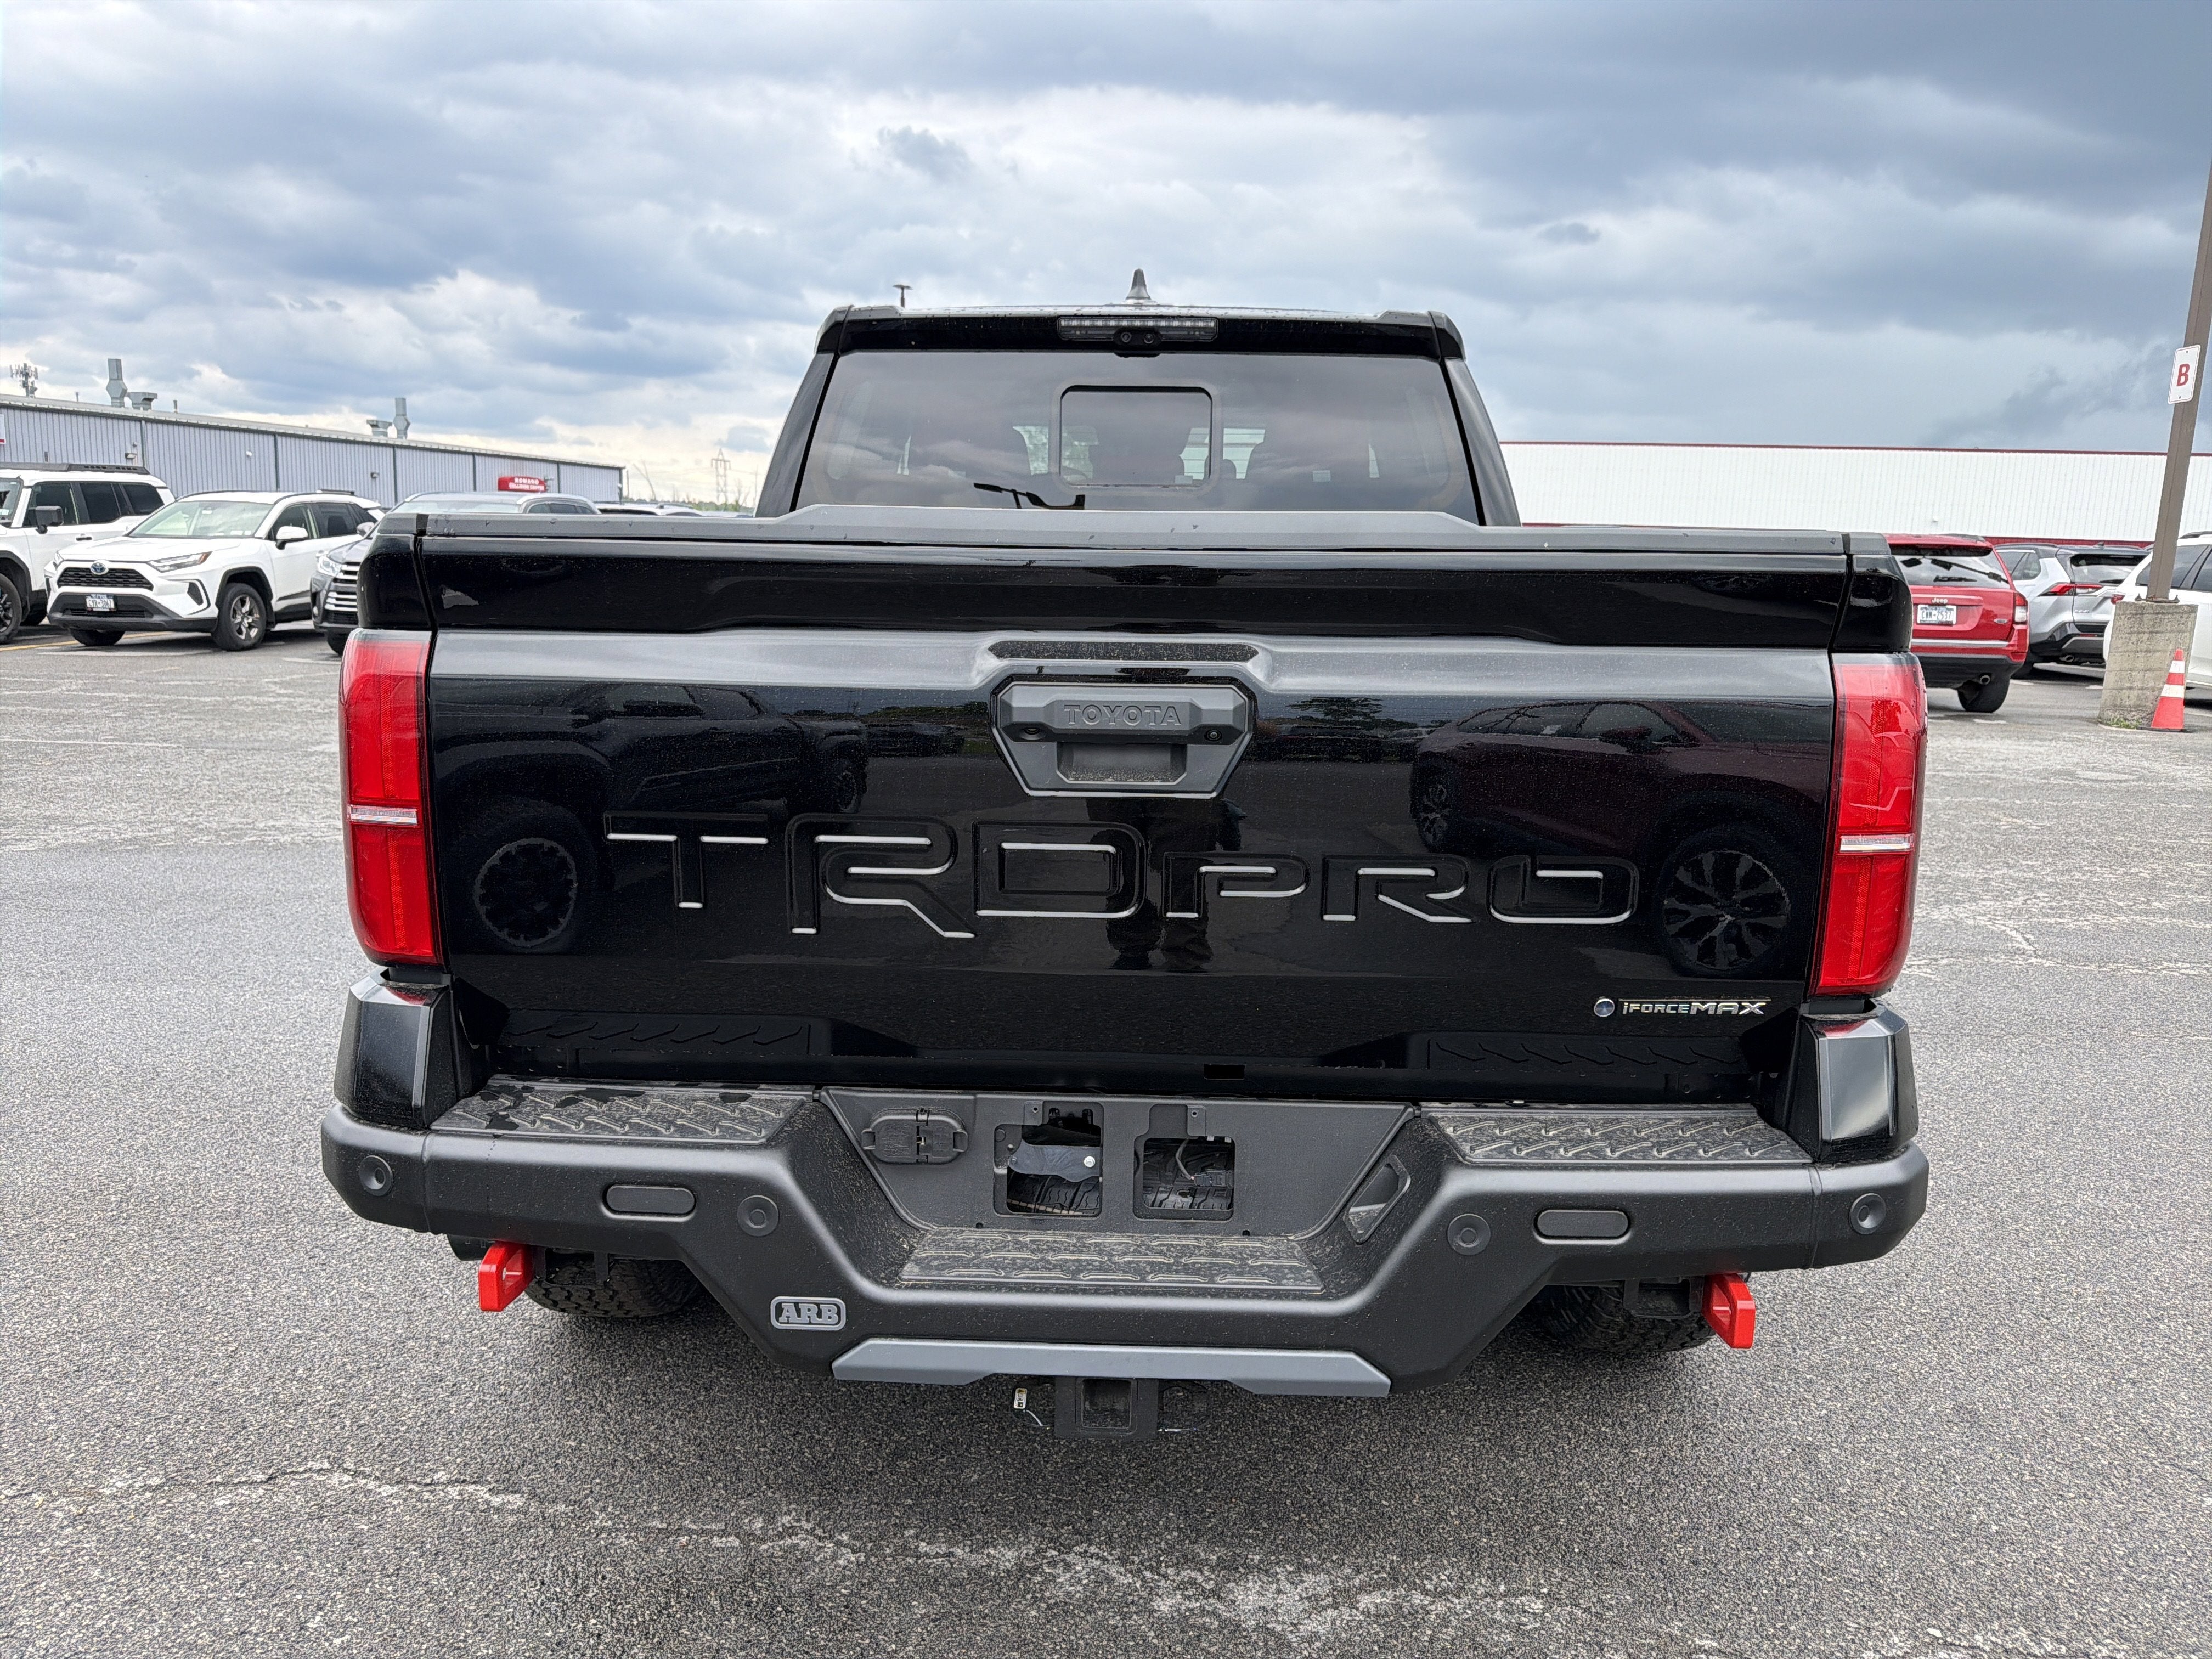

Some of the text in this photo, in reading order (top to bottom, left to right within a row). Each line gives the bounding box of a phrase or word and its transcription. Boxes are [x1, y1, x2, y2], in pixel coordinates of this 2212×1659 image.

[2176, 364, 2190, 387] B
[1064, 704, 1182, 726] TOYOTA
[603, 811, 1640, 938] TRD PRO
[778, 1303, 839, 1324] ARB
